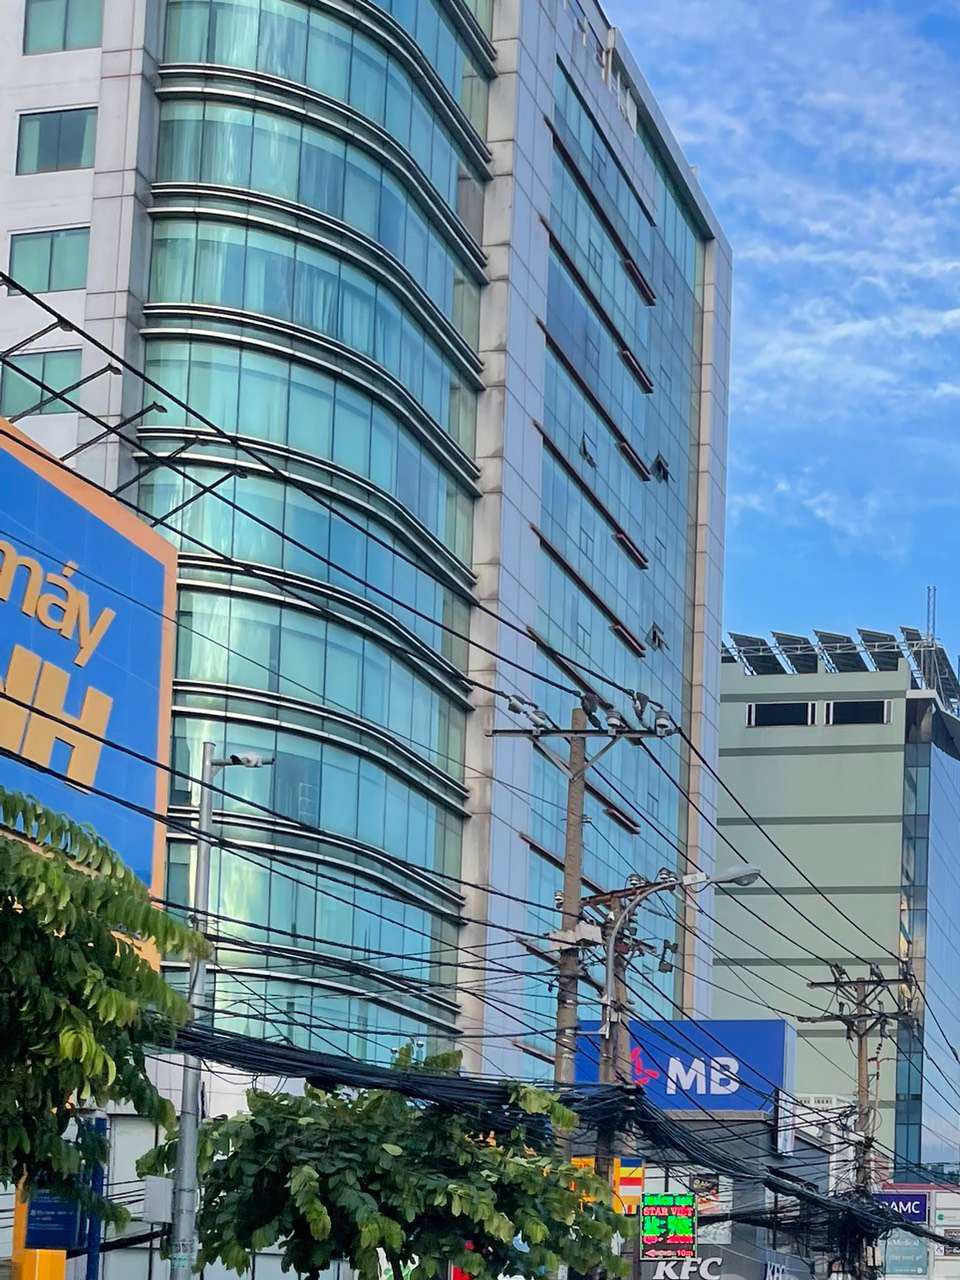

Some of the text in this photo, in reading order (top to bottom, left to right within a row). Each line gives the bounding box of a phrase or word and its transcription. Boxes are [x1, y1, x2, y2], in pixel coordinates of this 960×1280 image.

[666, 1056, 741, 1095] MB
[643, 1207, 669, 1216] STAR
[652, 1257, 723, 1280] KFC
